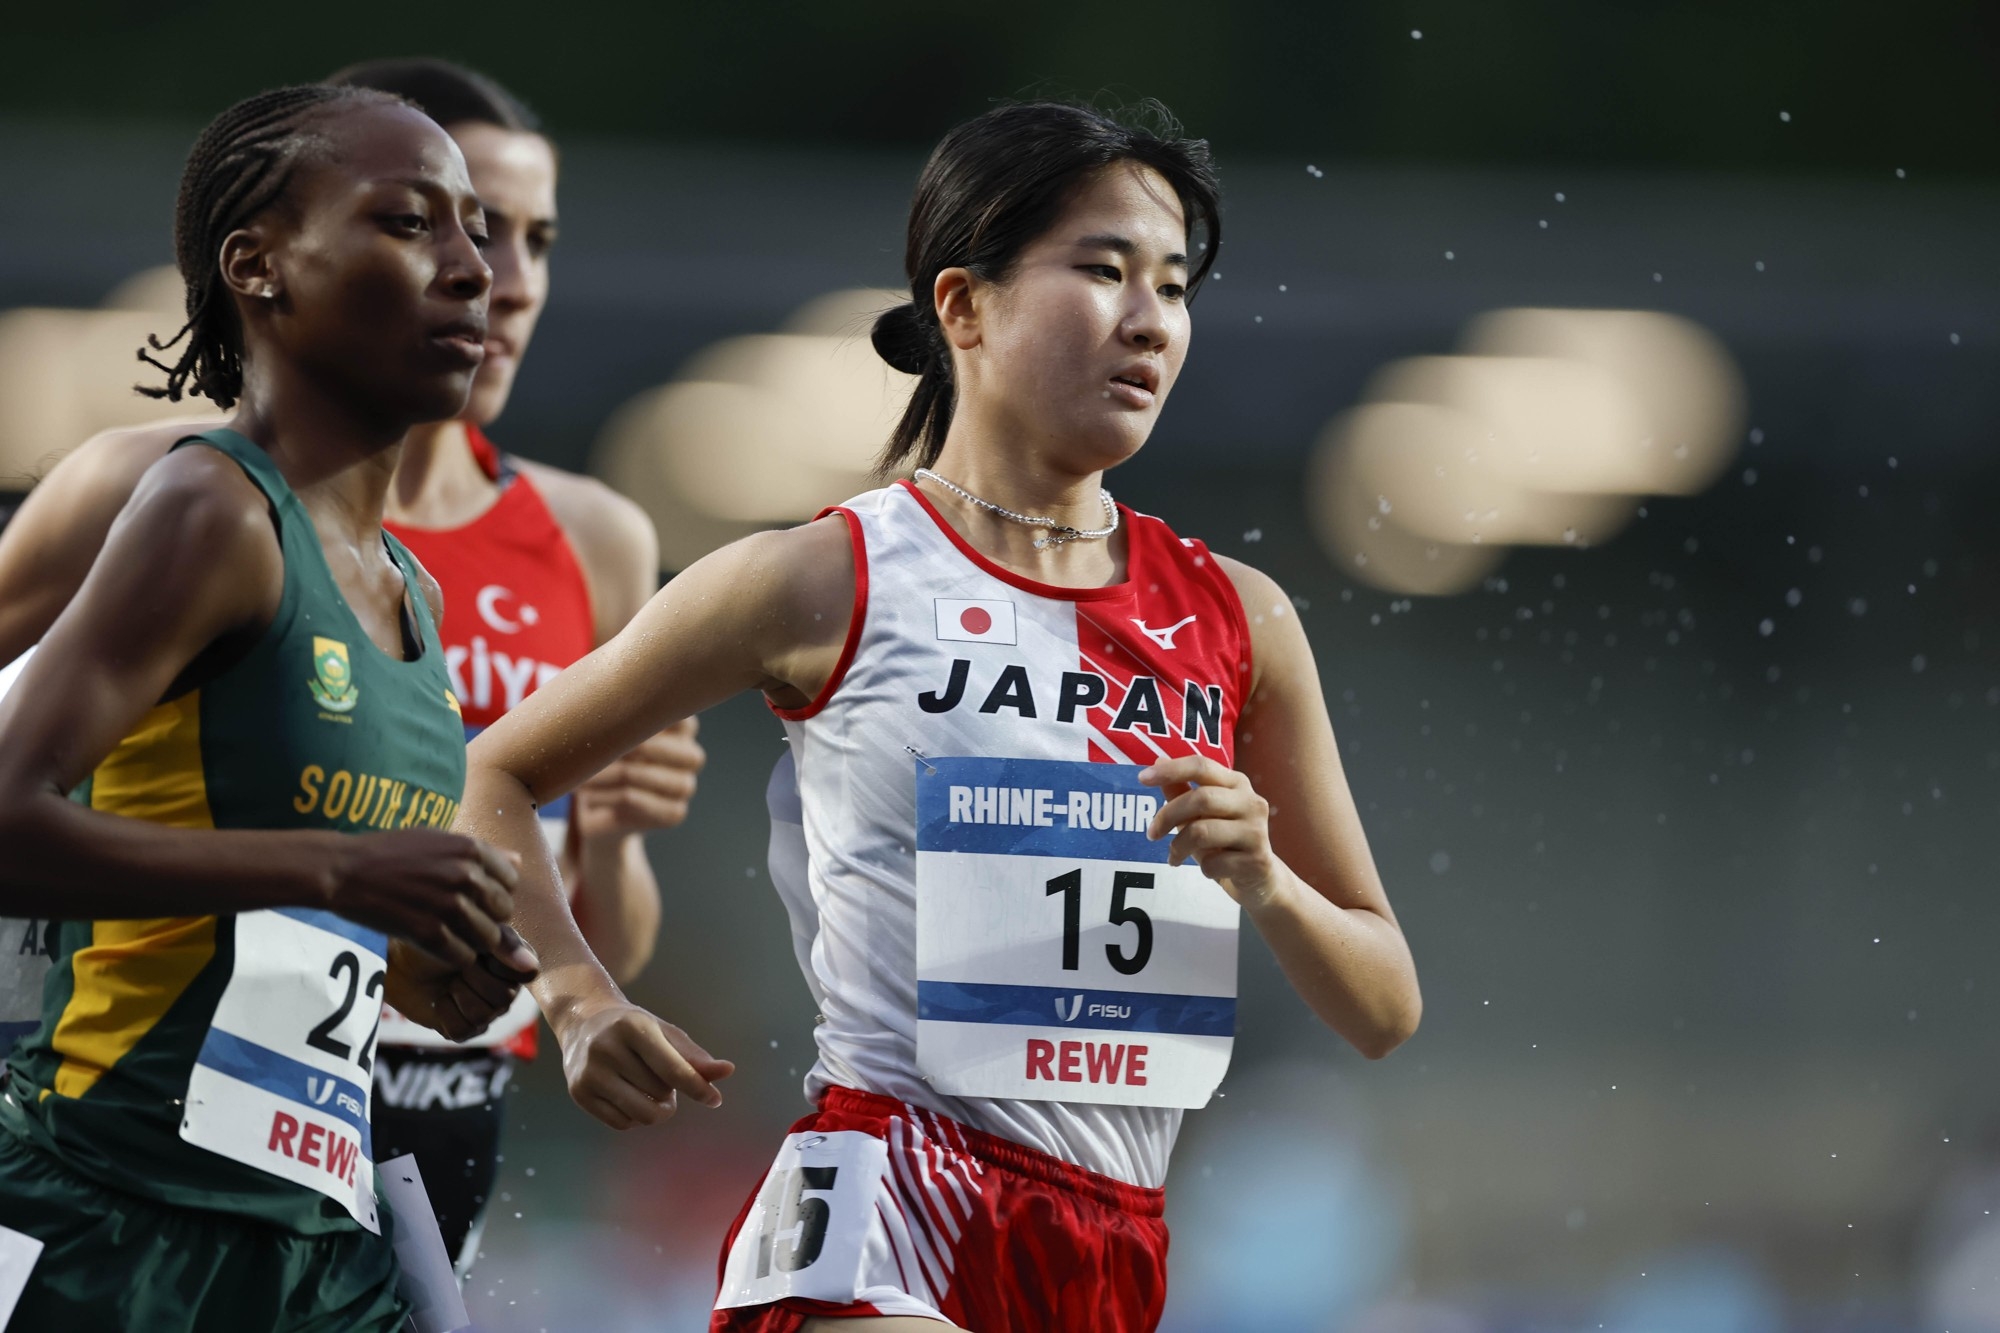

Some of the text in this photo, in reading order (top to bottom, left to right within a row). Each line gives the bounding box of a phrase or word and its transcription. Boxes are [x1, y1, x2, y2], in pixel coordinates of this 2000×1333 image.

[917, 658, 1223, 748] JAPAN
[293, 764, 407, 830] SOUTH
[1045, 867, 1156, 976] 15
[1088, 1003, 1132, 1019] FISU
[1026, 1038, 1149, 1086] REWE
